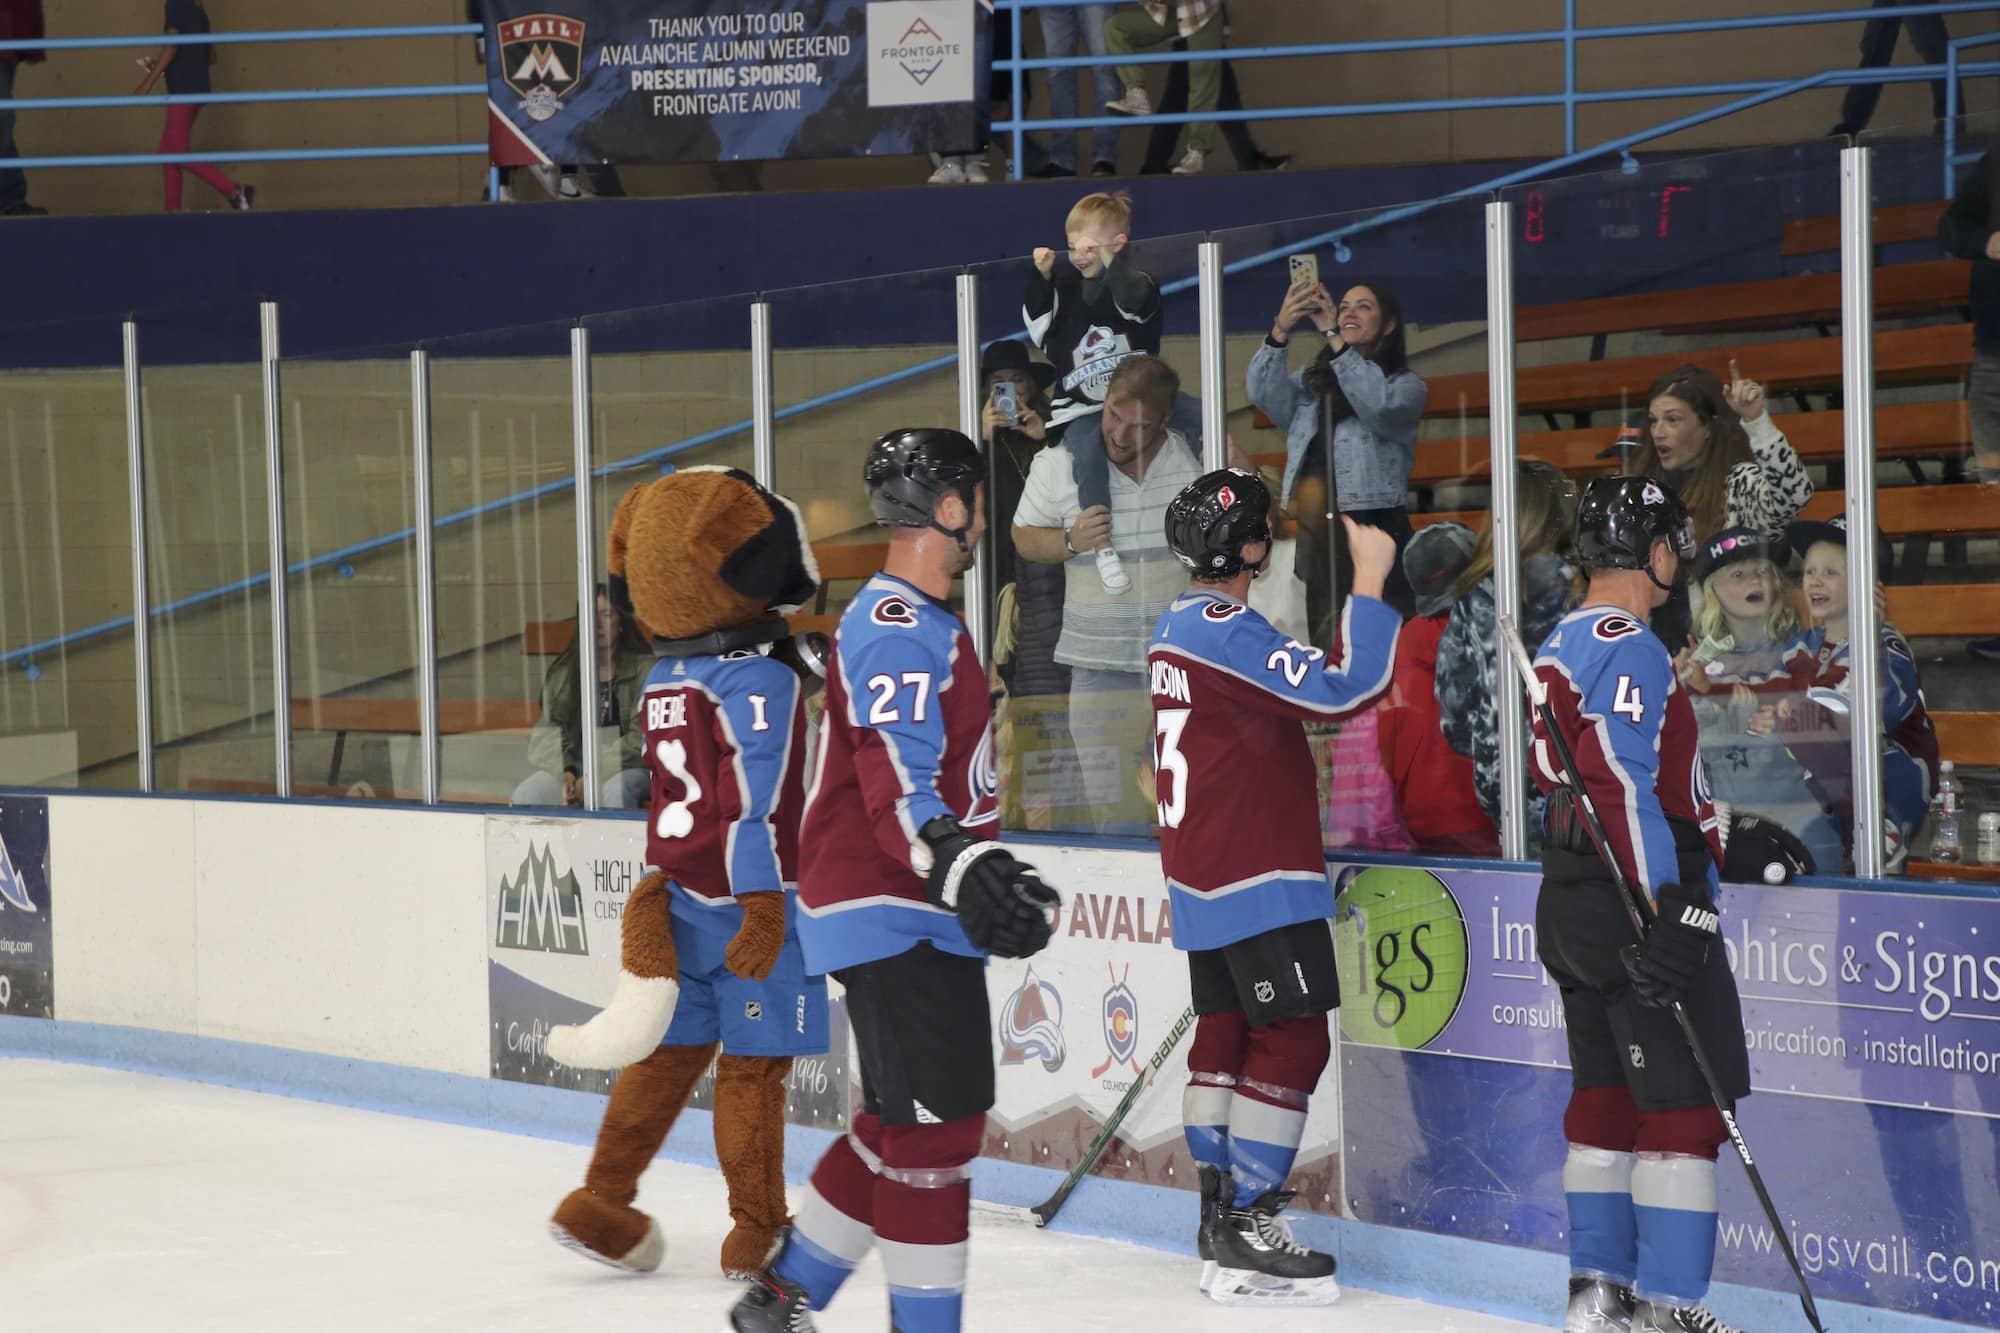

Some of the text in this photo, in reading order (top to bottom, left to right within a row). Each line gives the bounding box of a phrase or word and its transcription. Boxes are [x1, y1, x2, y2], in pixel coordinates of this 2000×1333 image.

[512, 20, 571, 38] VAIL
[648, 12, 804, 38] THANK YOU TO OUR
[600, 35, 850, 67] AVALANCHE ALUMNI WEEKEND
[881, 44, 960, 59] FRONTGATE
[631, 62, 823, 91] PRESENTING SPONSOR,
[653, 89, 801, 117] FRONTGATE AVON!
[1064, 355, 1121, 390] AVALAN
[748, 693, 769, 731] 1
[867, 671, 931, 726] 27
[1611, 674, 1645, 723] 4
[1154, 708, 1192, 829] 3
[594, 859, 632, 893] HIGH
[594, 900, 625, 920] CUST
[1068, 892, 1173, 945] AVALA
[1356, 909, 1435, 1029] igs
[1841, 945, 1863, 983] &
[1875, 930, 2000, 1021] Signs
[789, 1056, 828, 1094] 1996
[1722, 1110, 1754, 1165] EASTON
